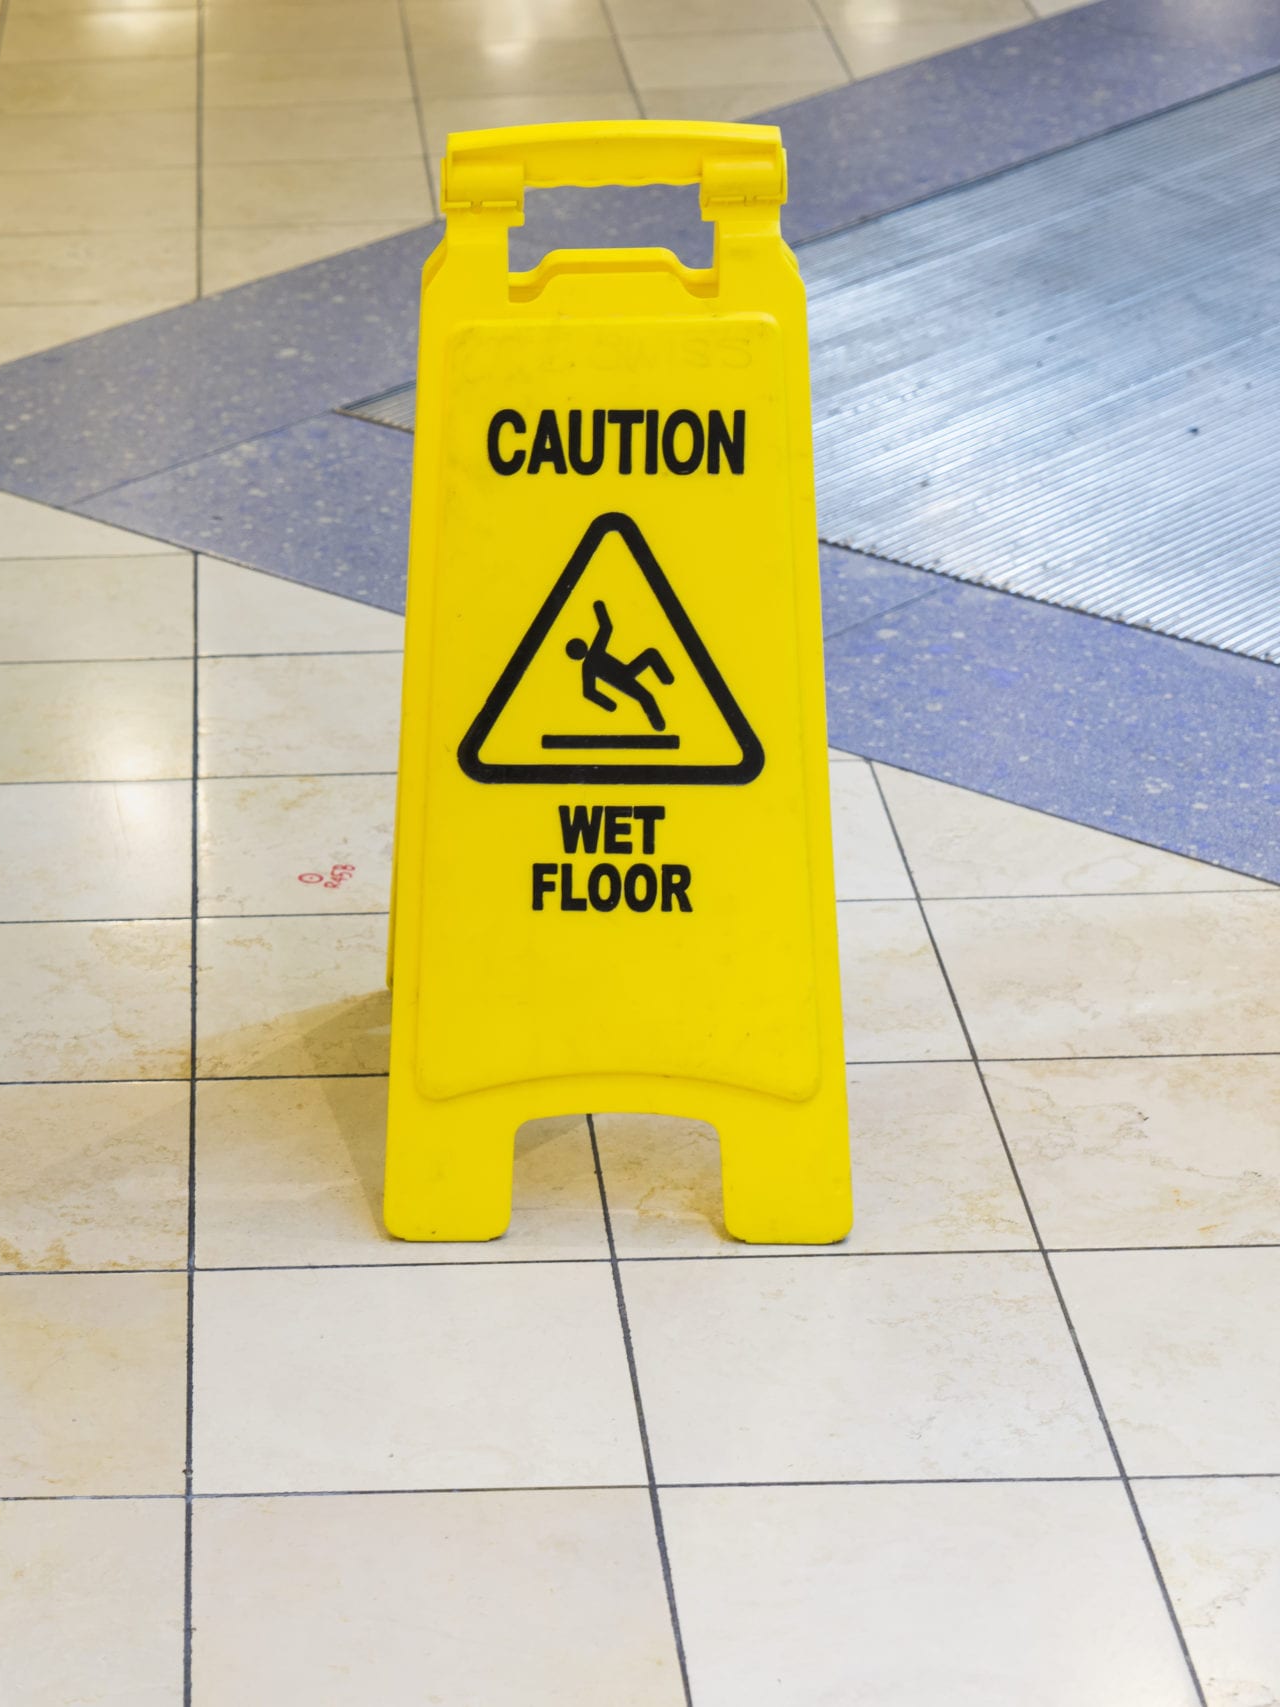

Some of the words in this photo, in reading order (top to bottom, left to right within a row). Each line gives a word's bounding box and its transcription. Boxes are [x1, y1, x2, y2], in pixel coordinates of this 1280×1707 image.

[487, 408, 746, 476] CAUTION
[558, 805, 666, 855] WET
[532, 862, 693, 913] FLOOR
